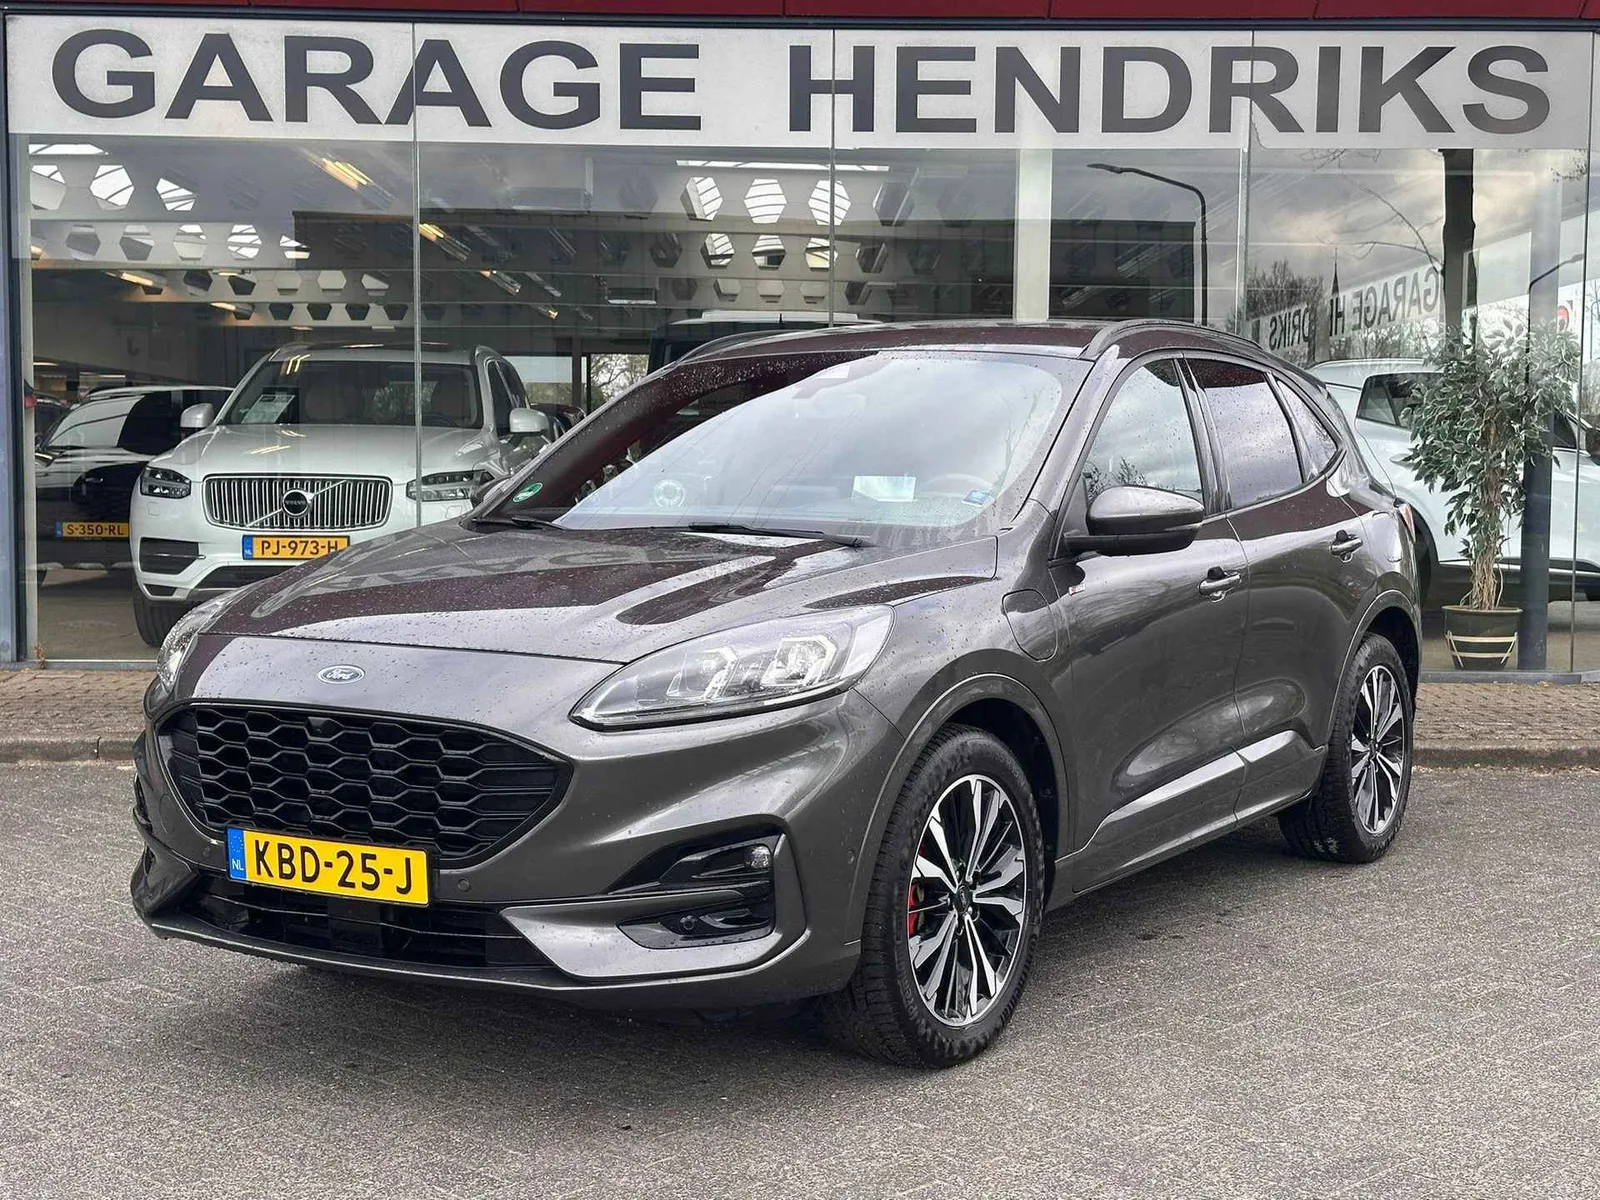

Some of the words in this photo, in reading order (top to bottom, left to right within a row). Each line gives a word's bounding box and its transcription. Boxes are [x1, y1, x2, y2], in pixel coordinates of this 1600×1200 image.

[51, 29, 702, 131] GARAGE
[789, 45, 1551, 134] HENDRIKS
[66, 524, 125, 535] S-350-RL
[261, 540, 338, 556] PJ-973-H
[232, 858, 244, 871] NL
[254, 839, 413, 895] KBD-25-J
